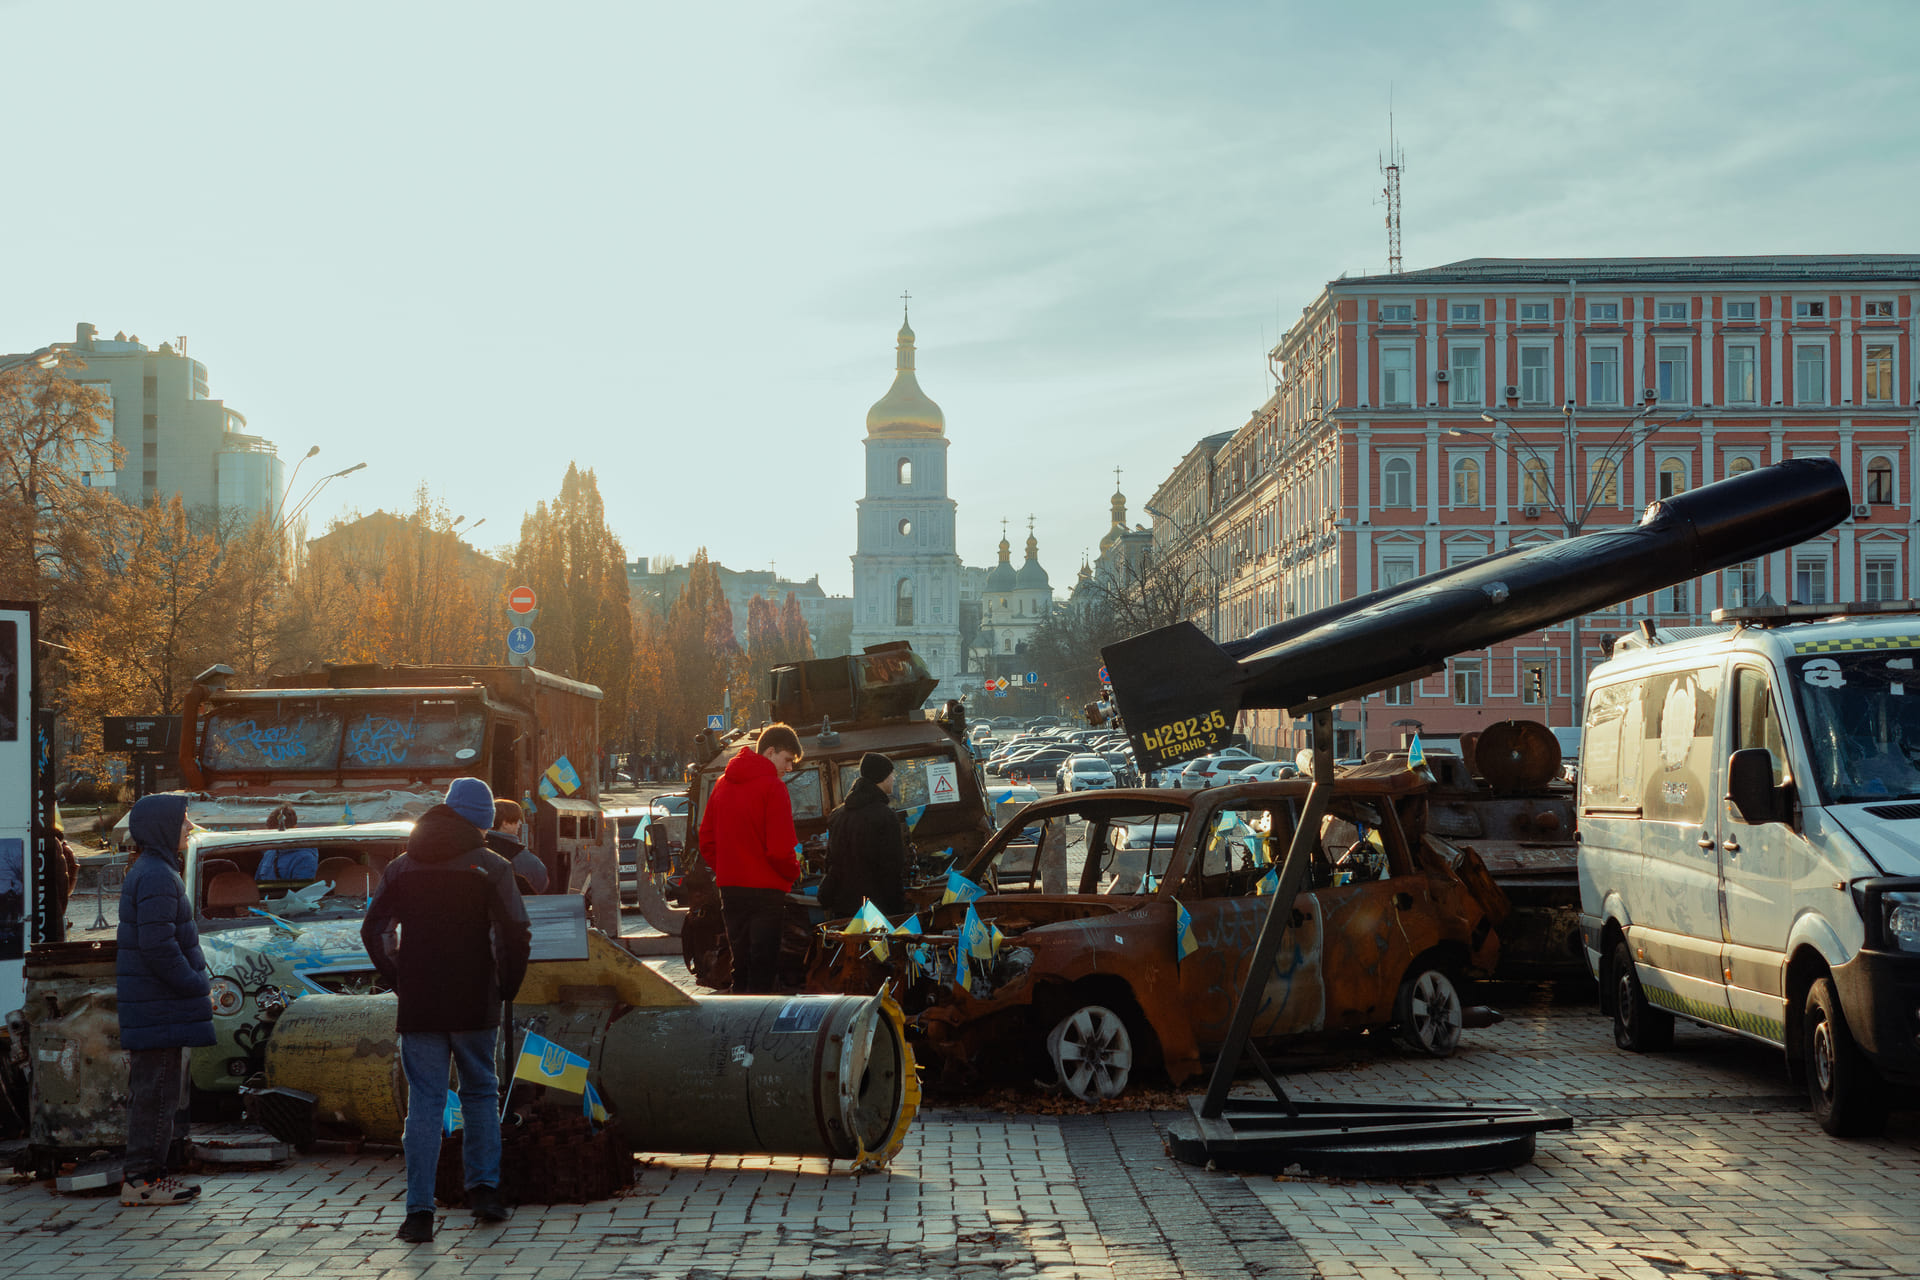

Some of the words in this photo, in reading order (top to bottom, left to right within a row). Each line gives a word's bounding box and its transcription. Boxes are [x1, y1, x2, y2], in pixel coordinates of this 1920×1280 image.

[1142, 710, 1225, 751] Ы29235
[1161, 738, 1206, 759] ГЕРАНЬ
[1209, 732, 1218, 744] 2
